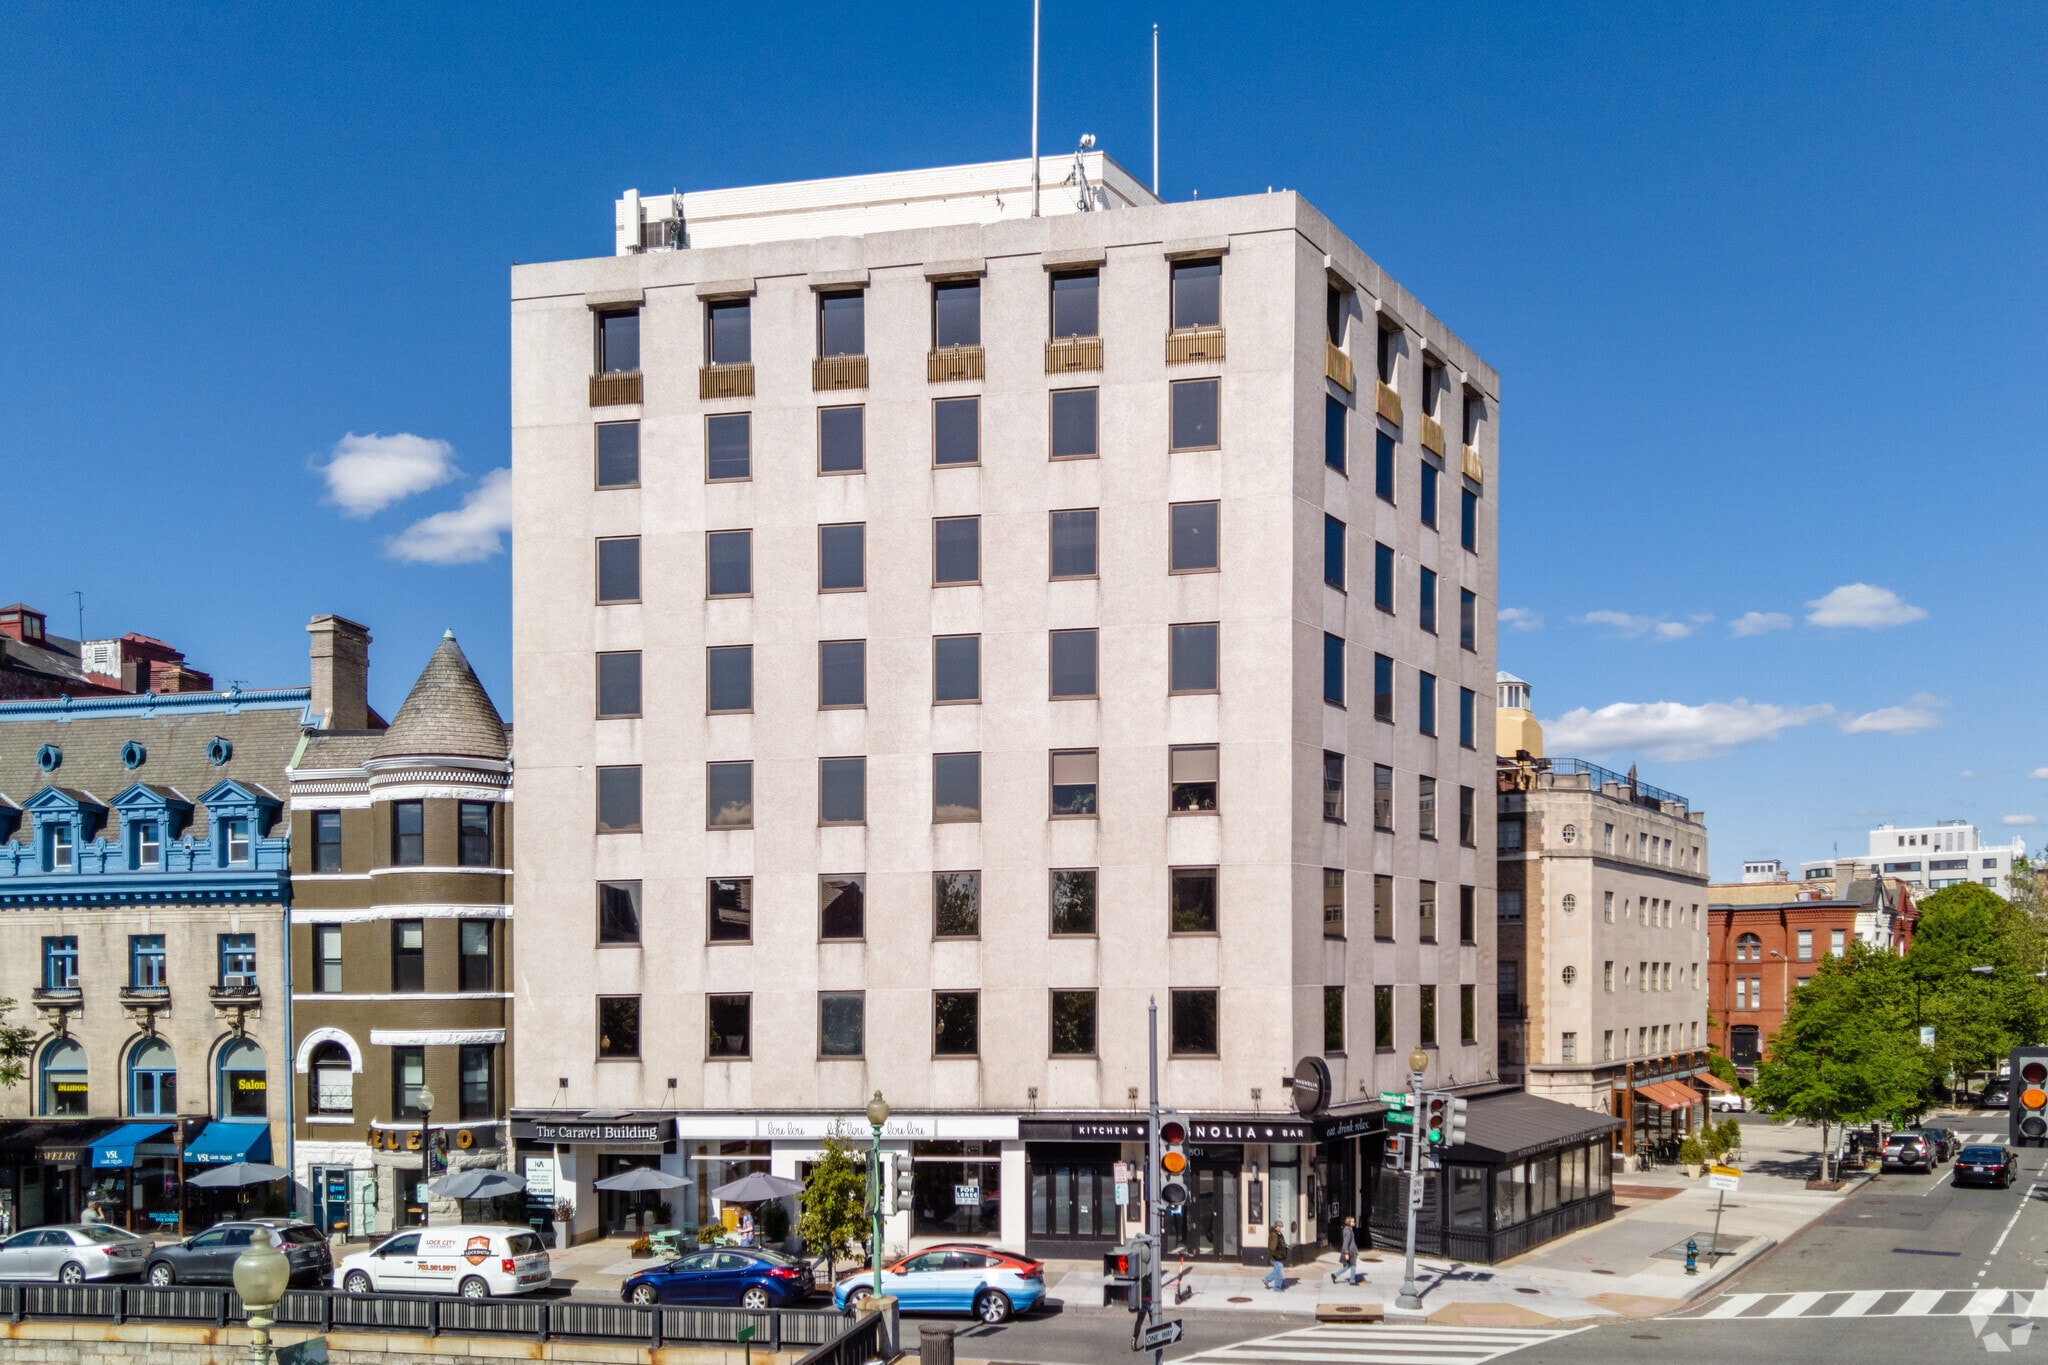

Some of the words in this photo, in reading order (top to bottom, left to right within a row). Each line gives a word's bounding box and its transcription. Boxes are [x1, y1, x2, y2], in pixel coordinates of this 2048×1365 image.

[57, 1083, 89, 1092] Mimos
[238, 1079, 266, 1090] Salon
[536, 1126, 556, 1137] The
[558, 1126, 600, 1138] Caravel
[604, 1126, 658, 1140] Building
[767, 1121, 785, 1135] lou
[787, 1121, 805, 1135] lou
[887, 1121, 904, 1135] lou
[907, 1121, 925, 1135] lou
[1079, 1126, 1129, 1135] KITCHEN
[1186, 1126, 1257, 1139] NOLIA
[366, 1128, 473, 1150] ELEO
[1282, 1130, 1305, 1138] BAR
[35, 1151, 78, 1160] WELRY
[105, 1150, 119, 1159] VSL
[197, 1153, 209, 1162] VSL
[1146, 1333, 1158, 1344] ONE
[1161, 1329, 1173, 1339] WAY
